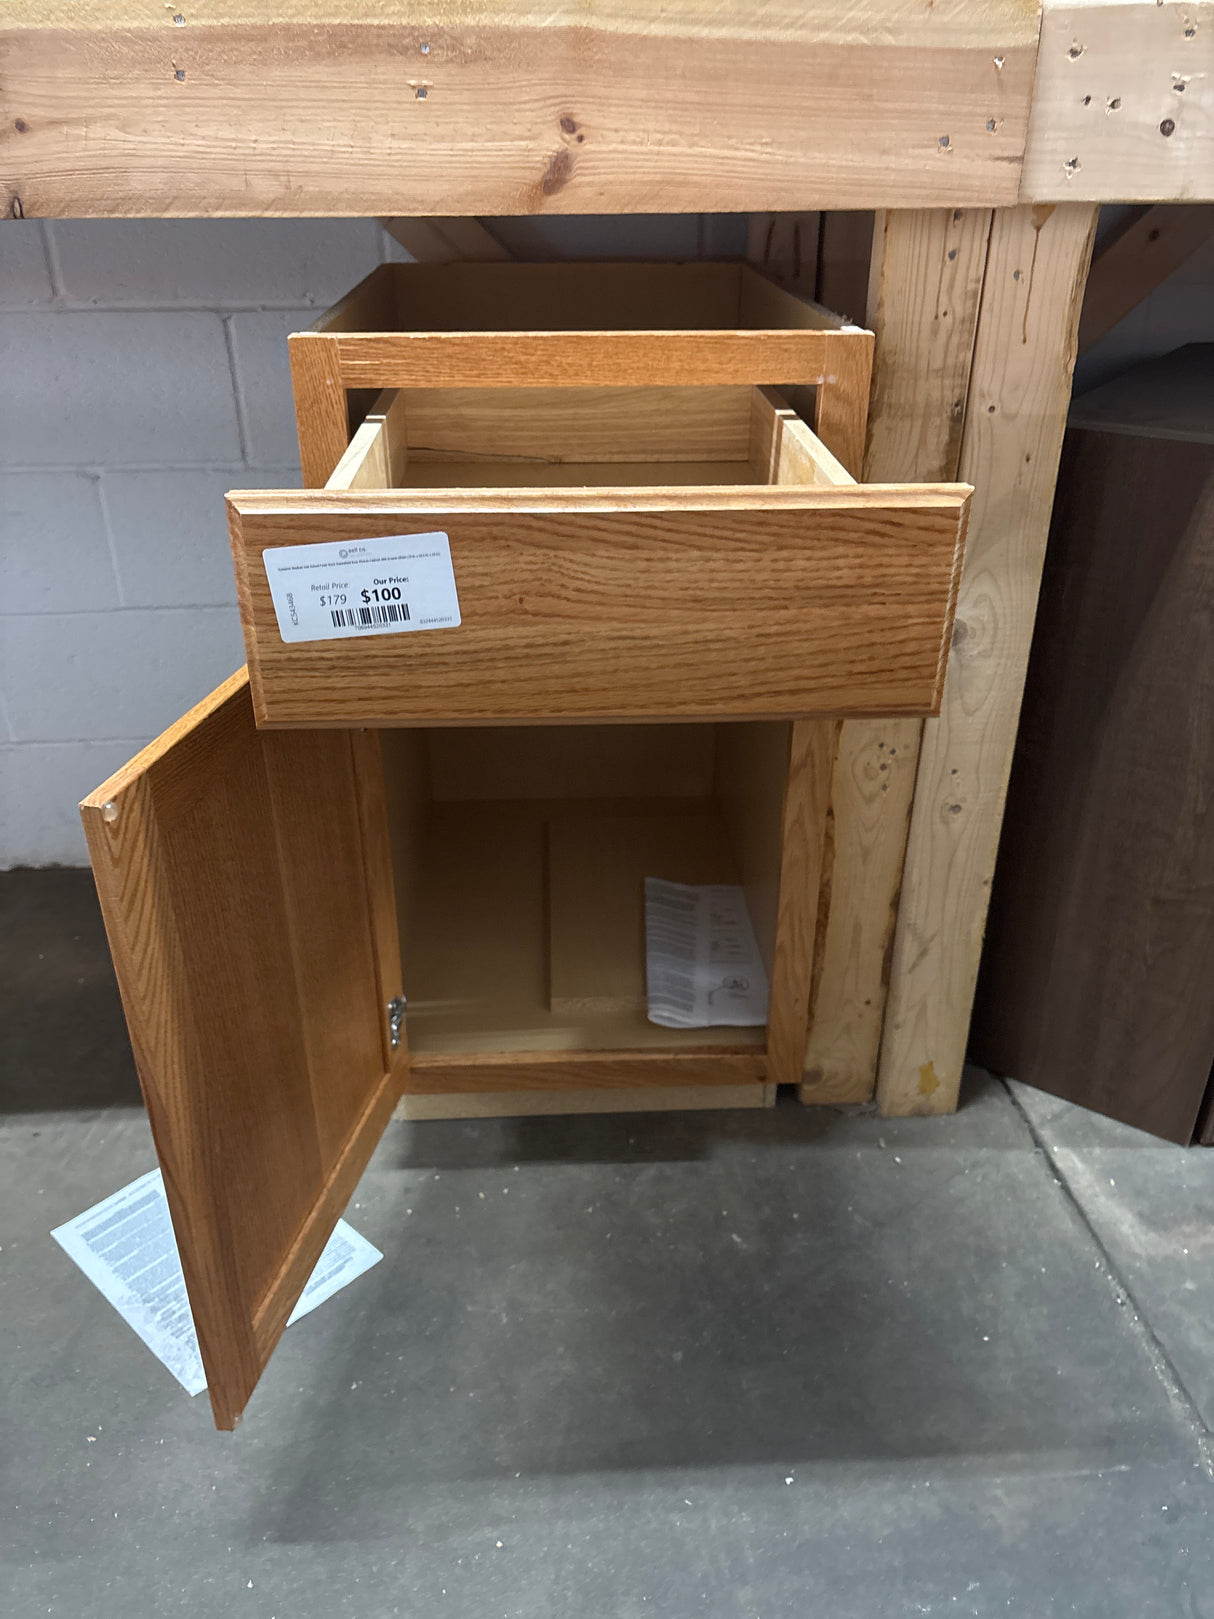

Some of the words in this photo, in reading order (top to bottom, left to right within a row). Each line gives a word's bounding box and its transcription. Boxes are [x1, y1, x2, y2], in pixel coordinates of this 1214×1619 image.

[388, 576, 409, 584] Price:
[310, 584, 330, 592] Retail
[319, 594, 347, 607] $179
[360, 587, 402, 604] $100
